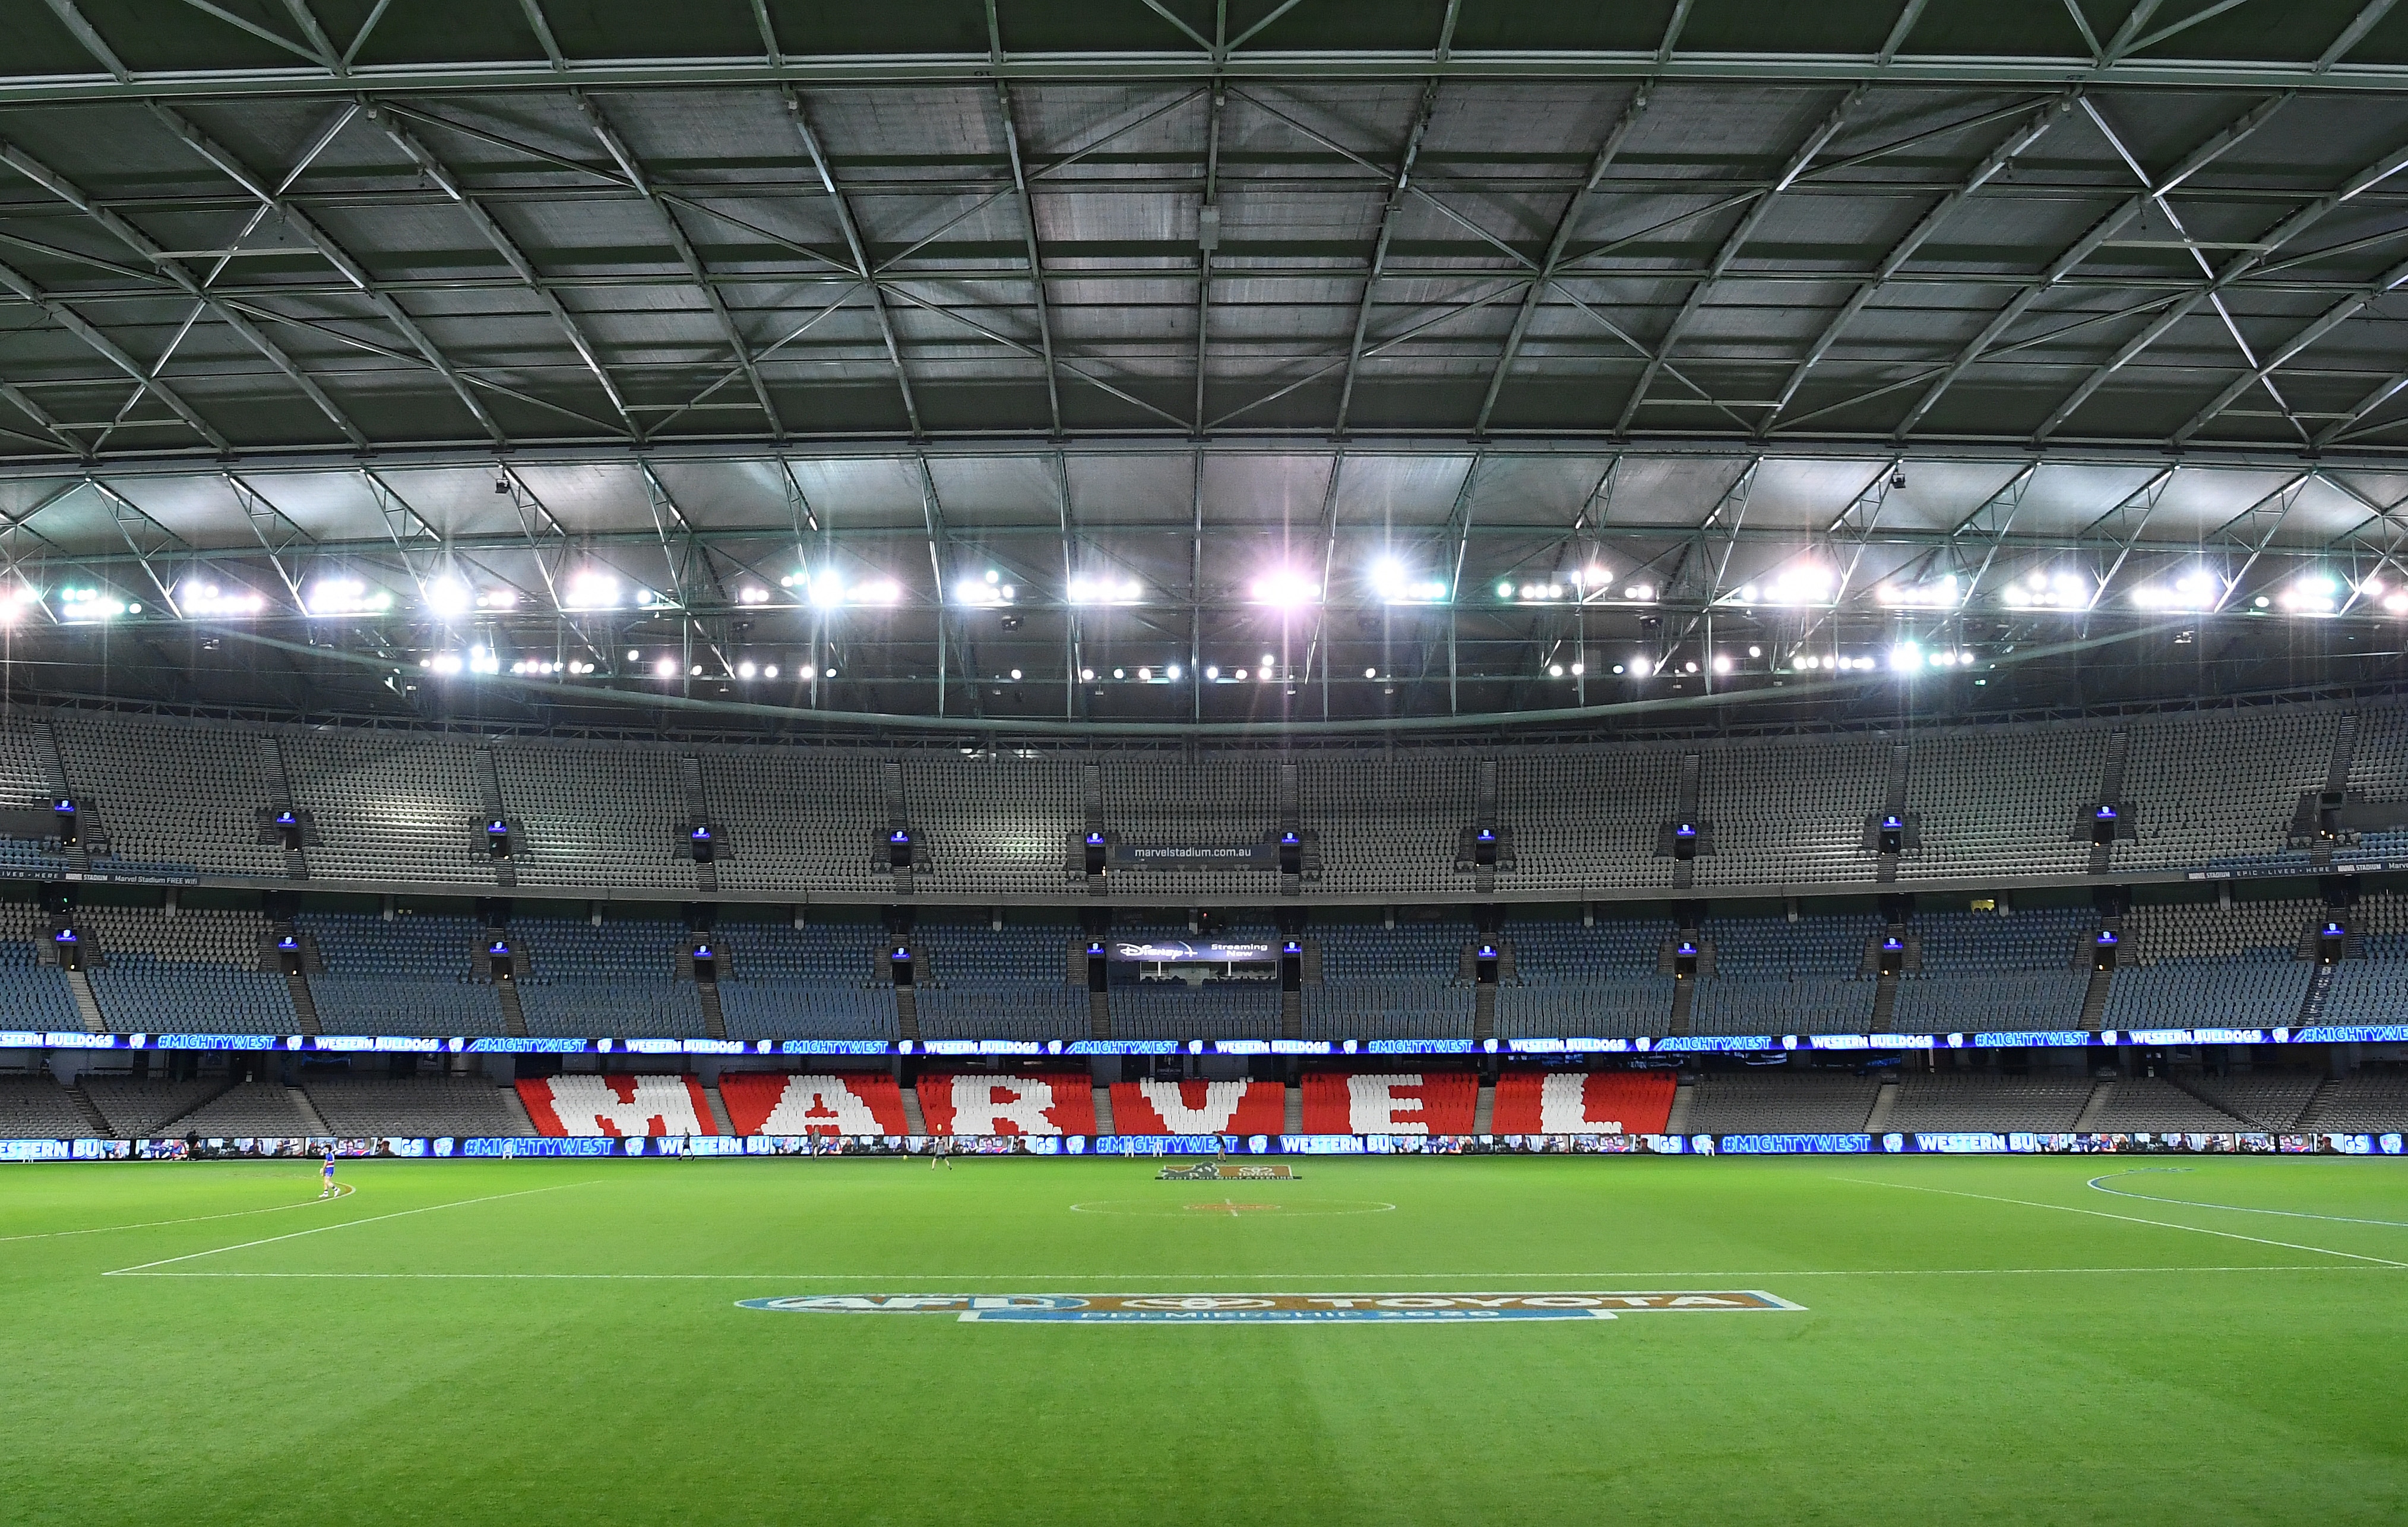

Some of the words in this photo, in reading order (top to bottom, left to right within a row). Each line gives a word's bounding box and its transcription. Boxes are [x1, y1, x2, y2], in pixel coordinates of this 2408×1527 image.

[1135, 847, 1251, 858] marvelstadium.com.au
[45, 1034, 113, 1047] BULLDOGS
[159, 1035, 276, 1049] #MIGHTYWEST
[1810, 1036, 1868, 1048] WESTERN
[1870, 1036, 1933, 1048] BULLDOGS
[1975, 1033, 2090, 1047] #MIGHTYWEST
[2131, 1031, 2194, 1044] WESTERN
[2194, 1030, 2261, 1042] BULLDOGS
[316, 1038, 371, 1049] WESTERN
[373, 1038, 439, 1050] BULLDOGS
[477, 1039, 587, 1052] #MIGHTYWEST
[625, 1041, 682, 1052] WESTERN
[684, 1041, 743, 1052] BULLDOGS
[783, 1041, 888, 1054] #MIGHTYWEST
[924, 1042, 979, 1053] WESTERN
[980, 1042, 1039, 1054] BULLDOGS
[1075, 1041, 1178, 1055] #MIGHTYWEST
[1216, 1042, 1270, 1054] WESTERN
[1271, 1042, 1330, 1054] BULLDOGS
[1368, 1041, 1473, 1054] #MIGHTYWEST
[1510, 1040, 1565, 1051] WESTERN
[1567, 1040, 1627, 1051] BULLDOGS
[1663, 1038, 1771, 1051] #MIGHTYWEST
[546, 1073, 1622, 1135] MARVEL
[466, 1137, 614, 1156] #MIGHTYWEST
[1281, 1136, 1364, 1153] WESTERN
[1722, 1135, 1871, 1152] #MIGHTYWEST
[1917, 1135, 2002, 1153] WESTERN
[1307, 1297, 1744, 1308] TOYOTA
